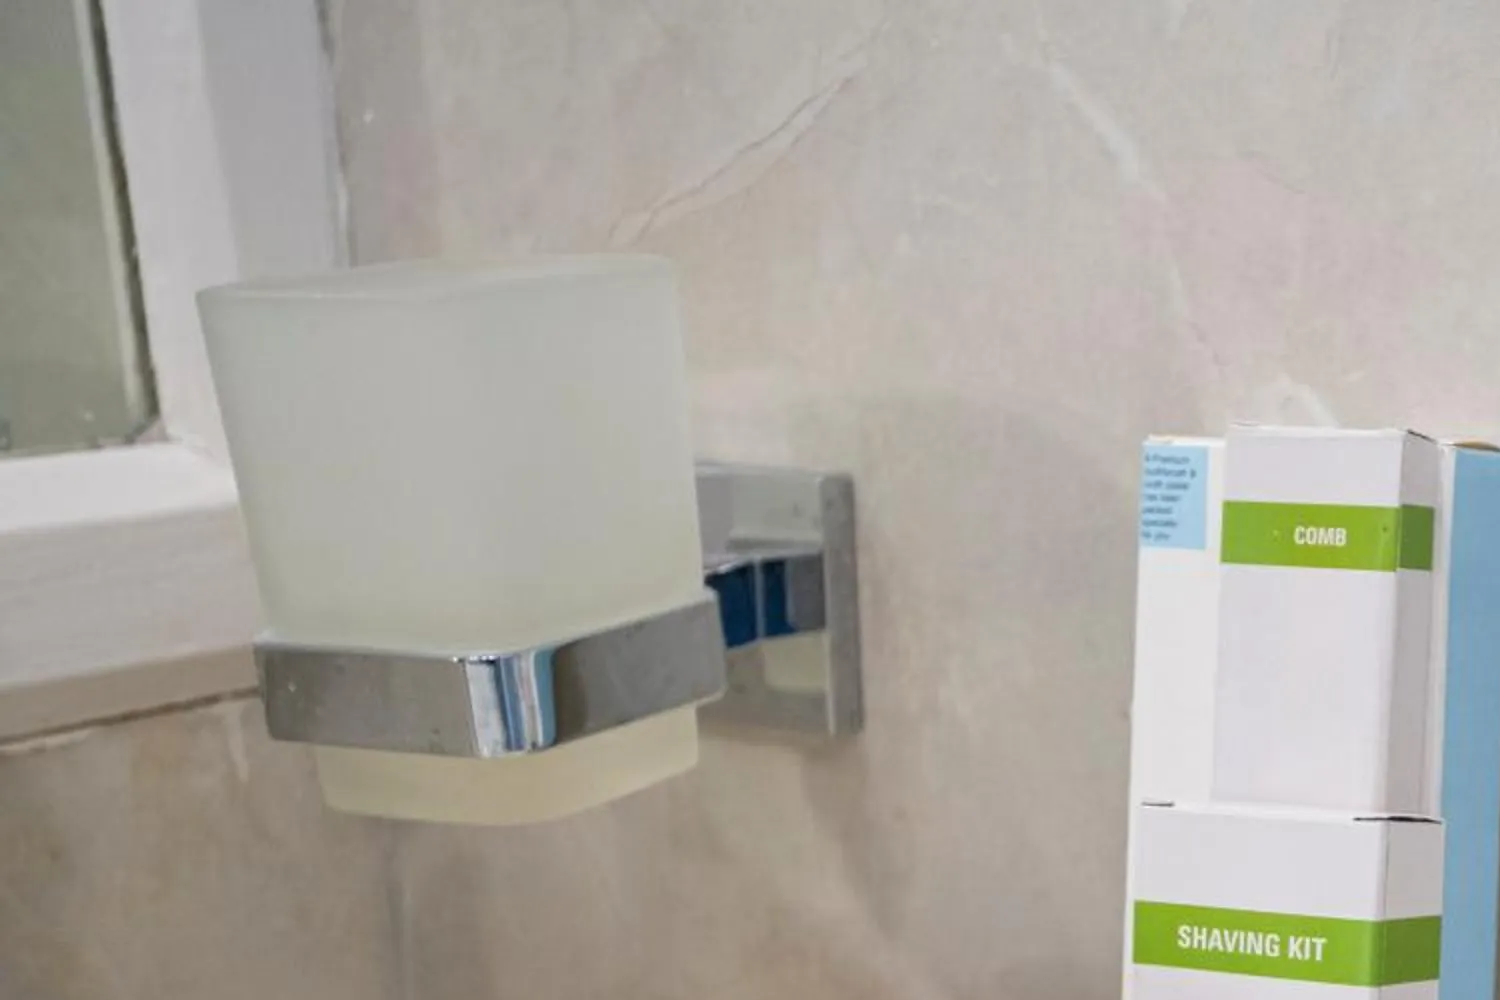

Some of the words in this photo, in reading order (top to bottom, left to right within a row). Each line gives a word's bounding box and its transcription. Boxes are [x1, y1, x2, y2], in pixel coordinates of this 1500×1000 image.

[1294, 525, 1347, 546] COMB
[1177, 924, 1281, 957] SHAVING
[1287, 936, 1328, 961] KIT
